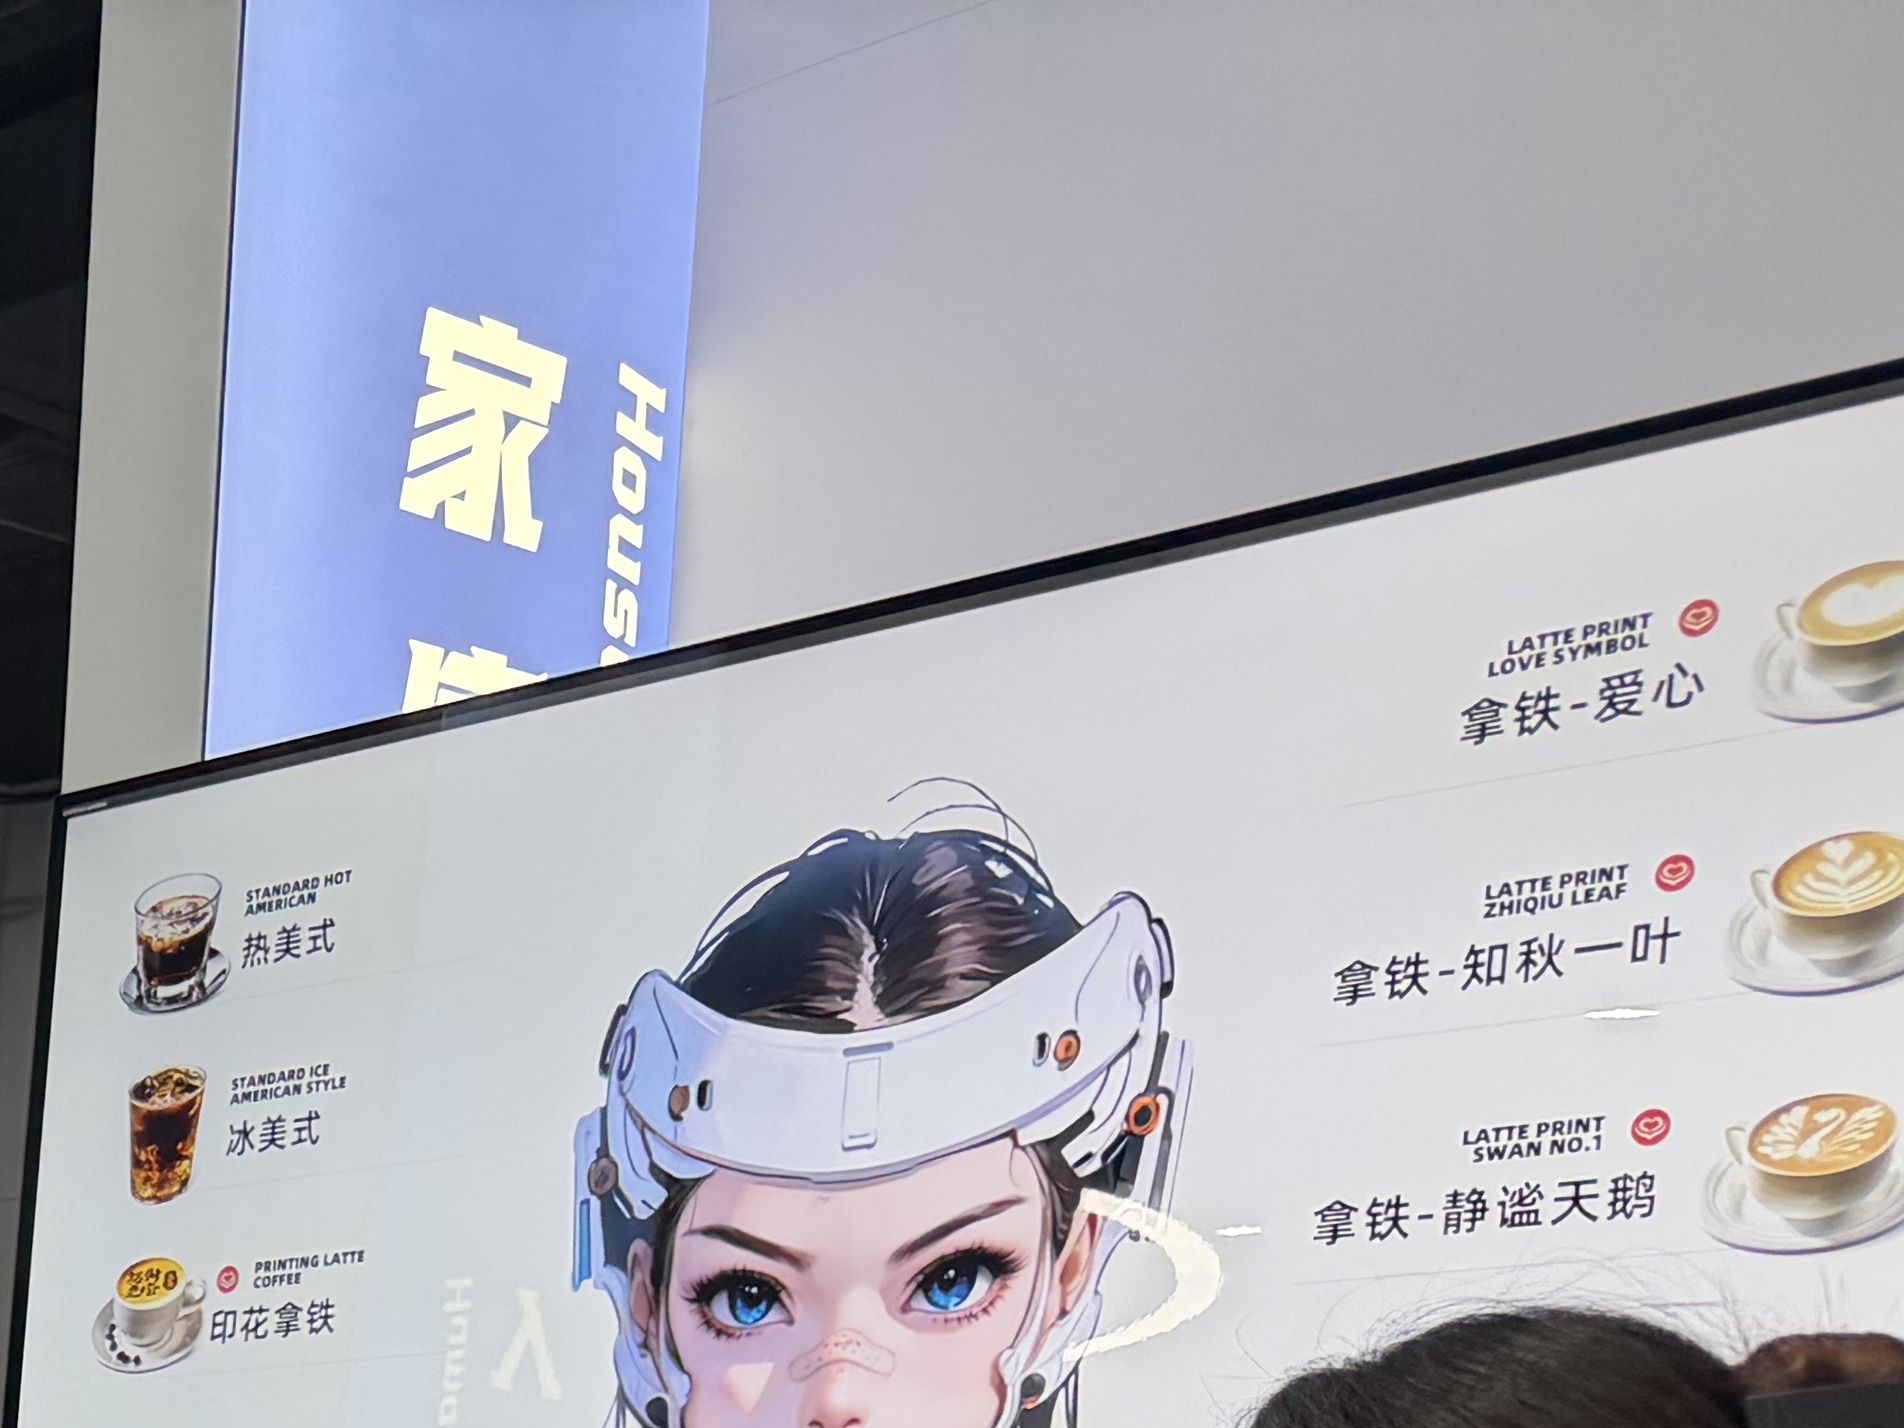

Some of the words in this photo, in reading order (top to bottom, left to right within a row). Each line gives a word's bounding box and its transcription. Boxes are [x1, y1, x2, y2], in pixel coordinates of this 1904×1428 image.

[600, 362, 667, 667] Hous
[1506, 625, 1575, 656] LATTE
[1582, 611, 1653, 642] PRINT
[1488, 649, 1546, 678] LOVE
[1552, 632, 1650, 665] SYMBOL
[1459, 662, 1705, 745] 拿铁-爱心
[246, 877, 320, 903] STANDARD
[324, 869, 352, 887] HOT
[1483, 893, 1564, 919] ZHIQIU
[1571, 881, 1627, 907] LEAF
[1484, 875, 1552, 900] LATTE
[1558, 863, 1629, 887] PRINT
[244, 892, 317, 917] AMERICAN
[241, 917, 336, 969] 热美式
[1333, 915, 1682, 1006] 拿铁-知秋一叶
[230, 1082, 302, 1105] AMERICAN
[306, 1076, 347, 1094] STYLE
[231, 1069, 306, 1091] STANDARD
[309, 1063, 331, 1077] ICE
[226, 1110, 321, 1156] 冰美式
[1462, 1121, 1530, 1146] LATTE
[1536, 1114, 1605, 1138] PRINT
[1472, 1140, 1542, 1163] SWAN
[1549, 1132, 1604, 1158] NO.1
[1313, 1171, 1656, 1245] 拿铁-静谧天鹅
[253, 1272, 302, 1289] COFFEE
[254, 1255, 319, 1273] PRINTING
[323, 1250, 365, 1266] LATTE
[210, 1297, 336, 1344] 印花拿铁
